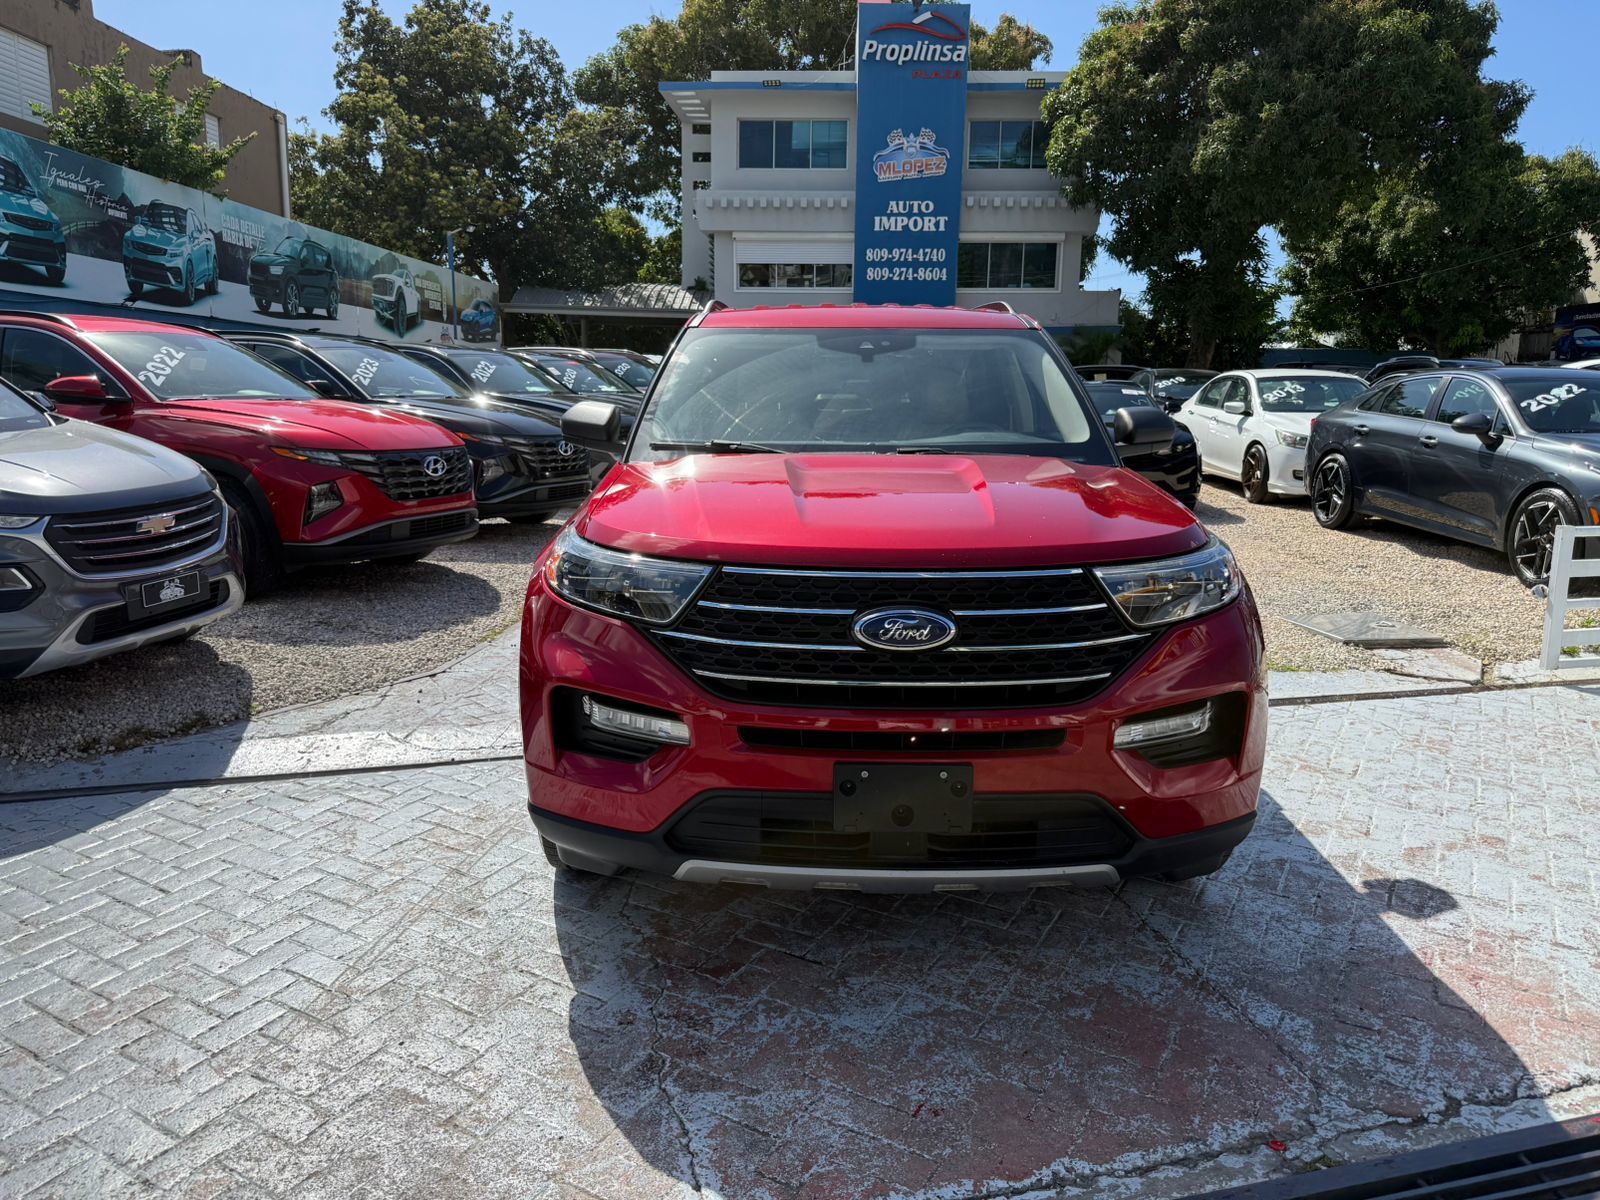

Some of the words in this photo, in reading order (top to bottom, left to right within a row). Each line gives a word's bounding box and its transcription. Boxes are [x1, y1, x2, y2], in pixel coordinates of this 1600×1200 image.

[862, 40, 967, 65] Proplinsa
[912, 70, 963, 80] PLAZA
[40, 151, 104, 188] Iguales
[878, 157, 946, 177] MLOPEZ
[887, 200, 934, 214] AUTO
[221, 214, 240, 231] CADA
[874, 216, 948, 232] IMPORT
[866, 248, 945, 262] 809-974-4740
[866, 267, 947, 281] 809-274-8604
[138, 346, 186, 387] 2022
[354, 358, 380, 386] 2023
[470, 360, 497, 383] 2022
[615, 362, 631, 377] 020
[1262, 384, 1306, 402] 2013
[1520, 383, 1588, 413] 2022
[879, 618, 932, 641] Ford
